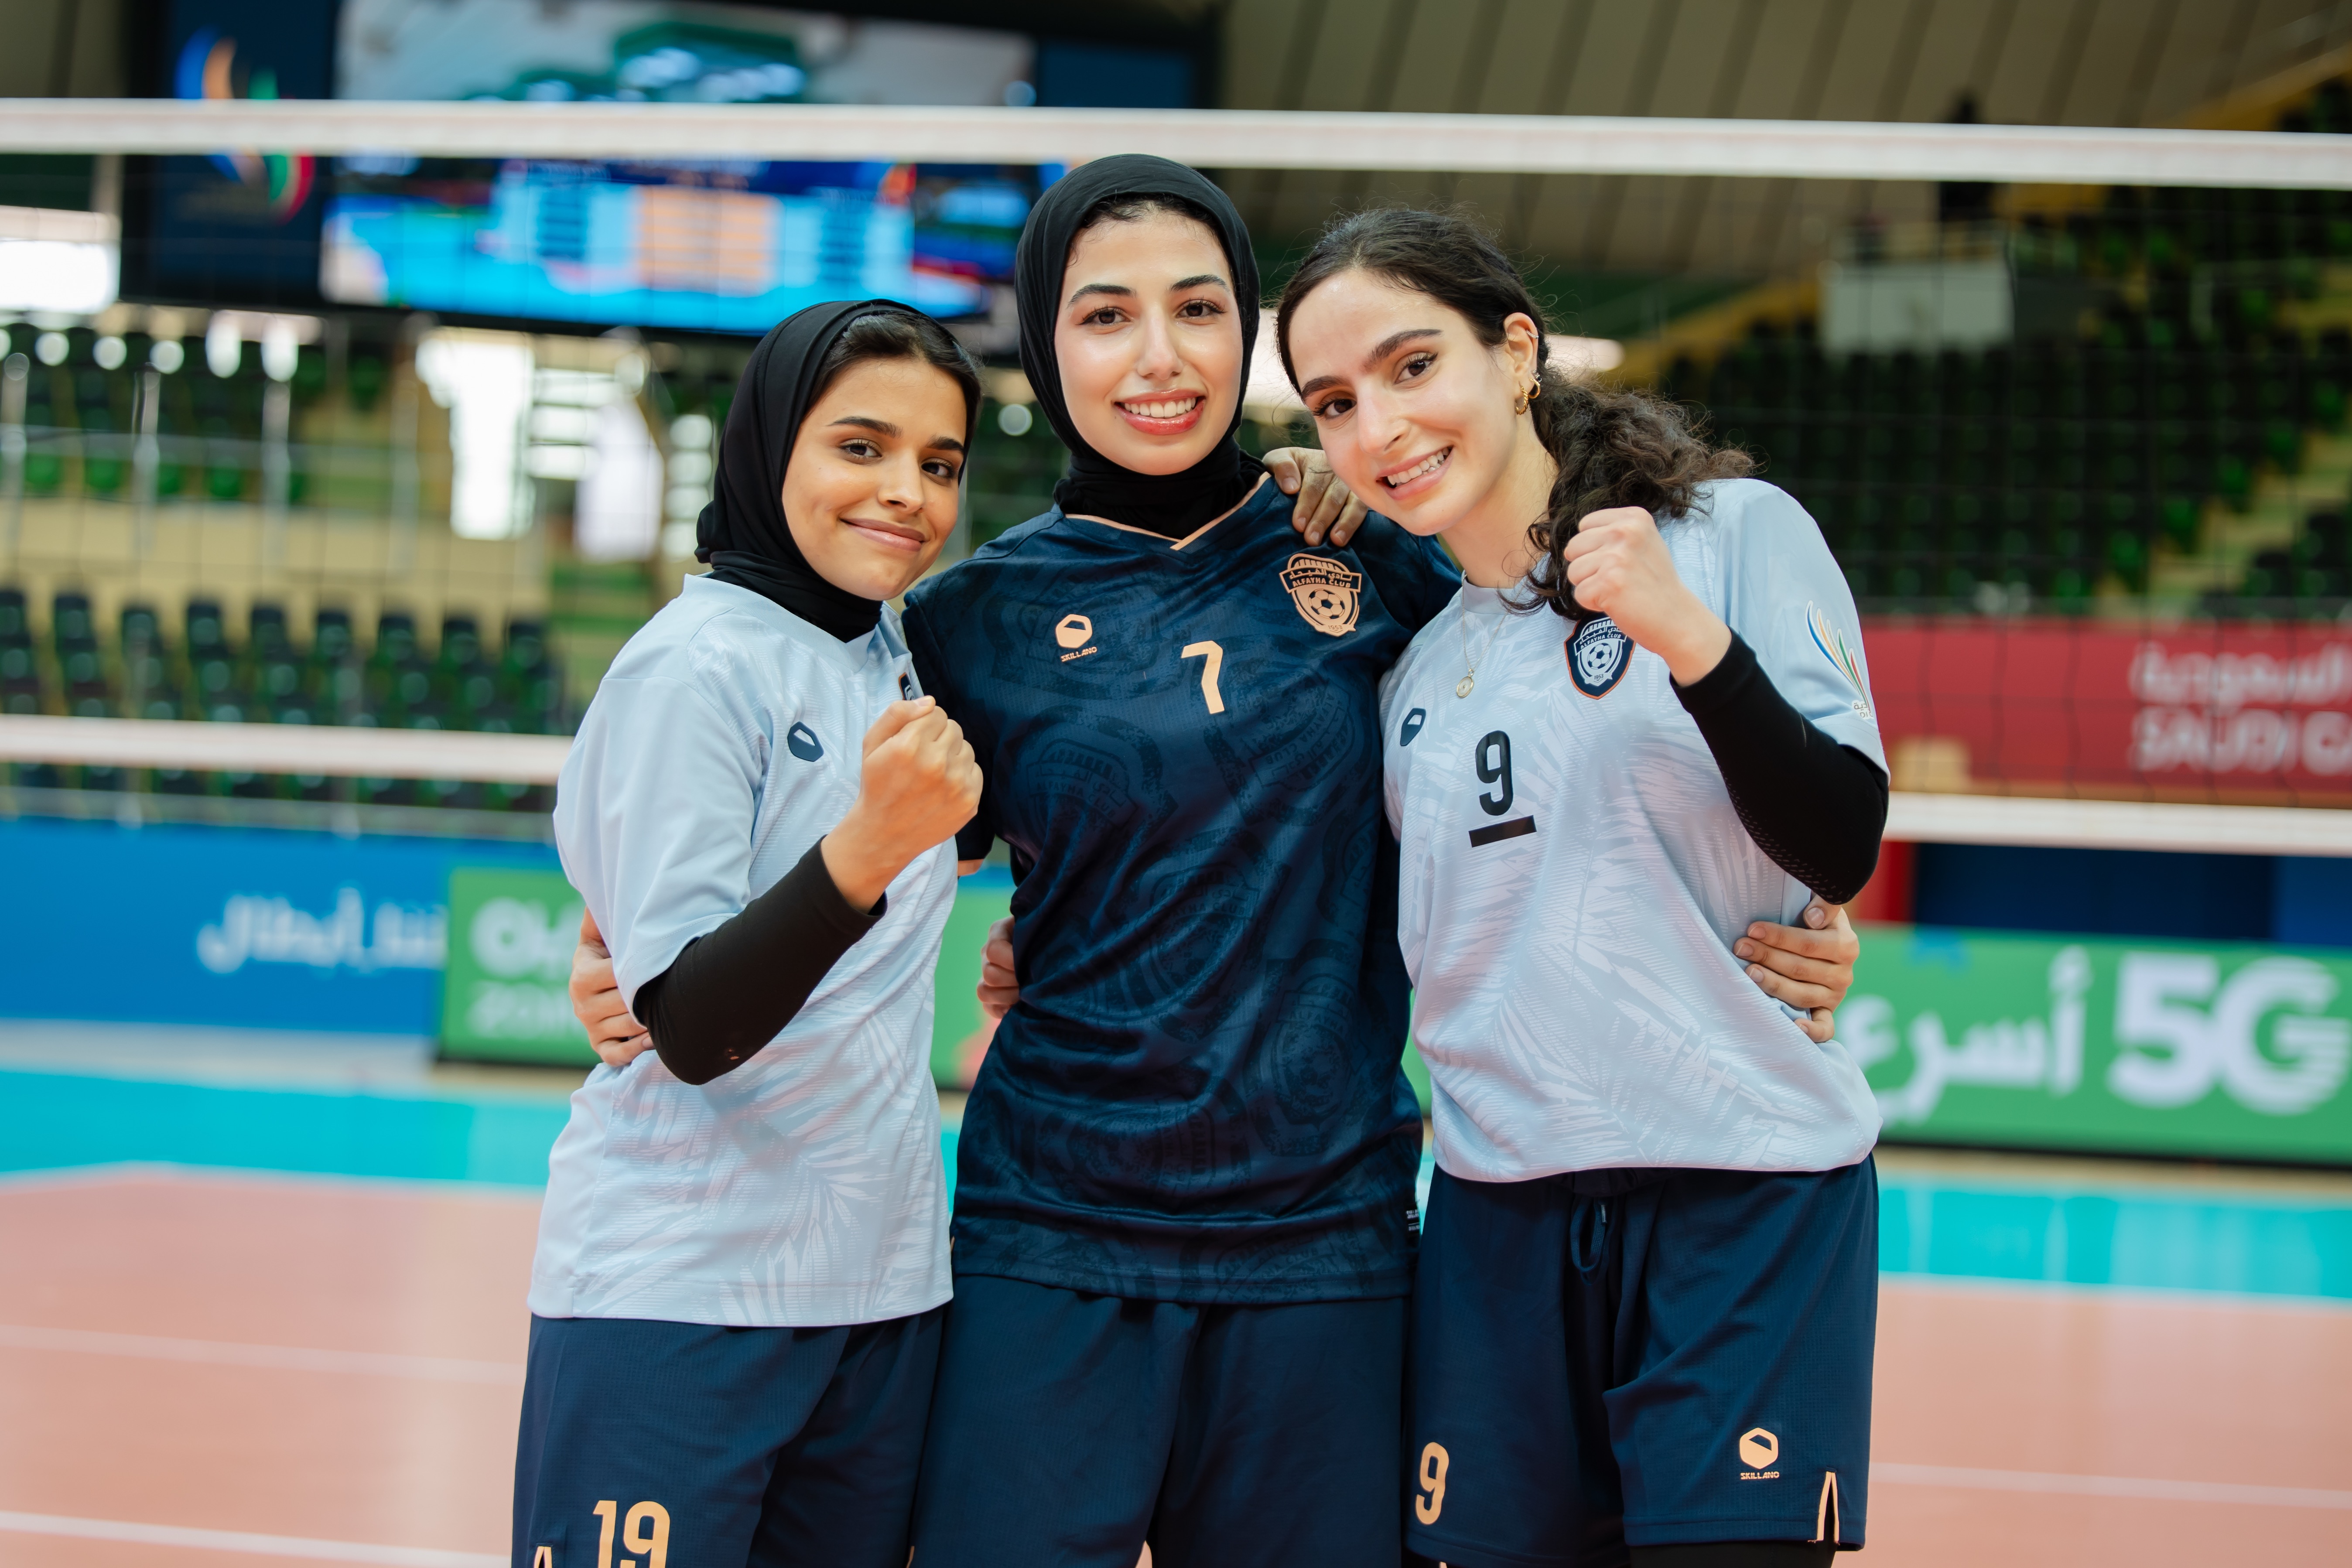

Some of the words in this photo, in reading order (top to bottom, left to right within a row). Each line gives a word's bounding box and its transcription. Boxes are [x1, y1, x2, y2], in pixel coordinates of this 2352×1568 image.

[1292, 577, 1326, 588] ALFAYHA
[1329, 580, 1351, 588] CLUB
[1060, 646, 1097, 663] SKILLANO
[1580, 635, 1605, 650] ALFAYHA
[1180, 640, 1224, 714] 7
[1475, 730, 1514, 816] 9
[2131, 710, 2297, 773] SAUDI
[2111, 952, 2350, 1113] 5G
[1415, 1441, 1450, 1526] 9
[1740, 1471, 1780, 1480] SKILLANO
[593, 1500, 670, 1568] 19
